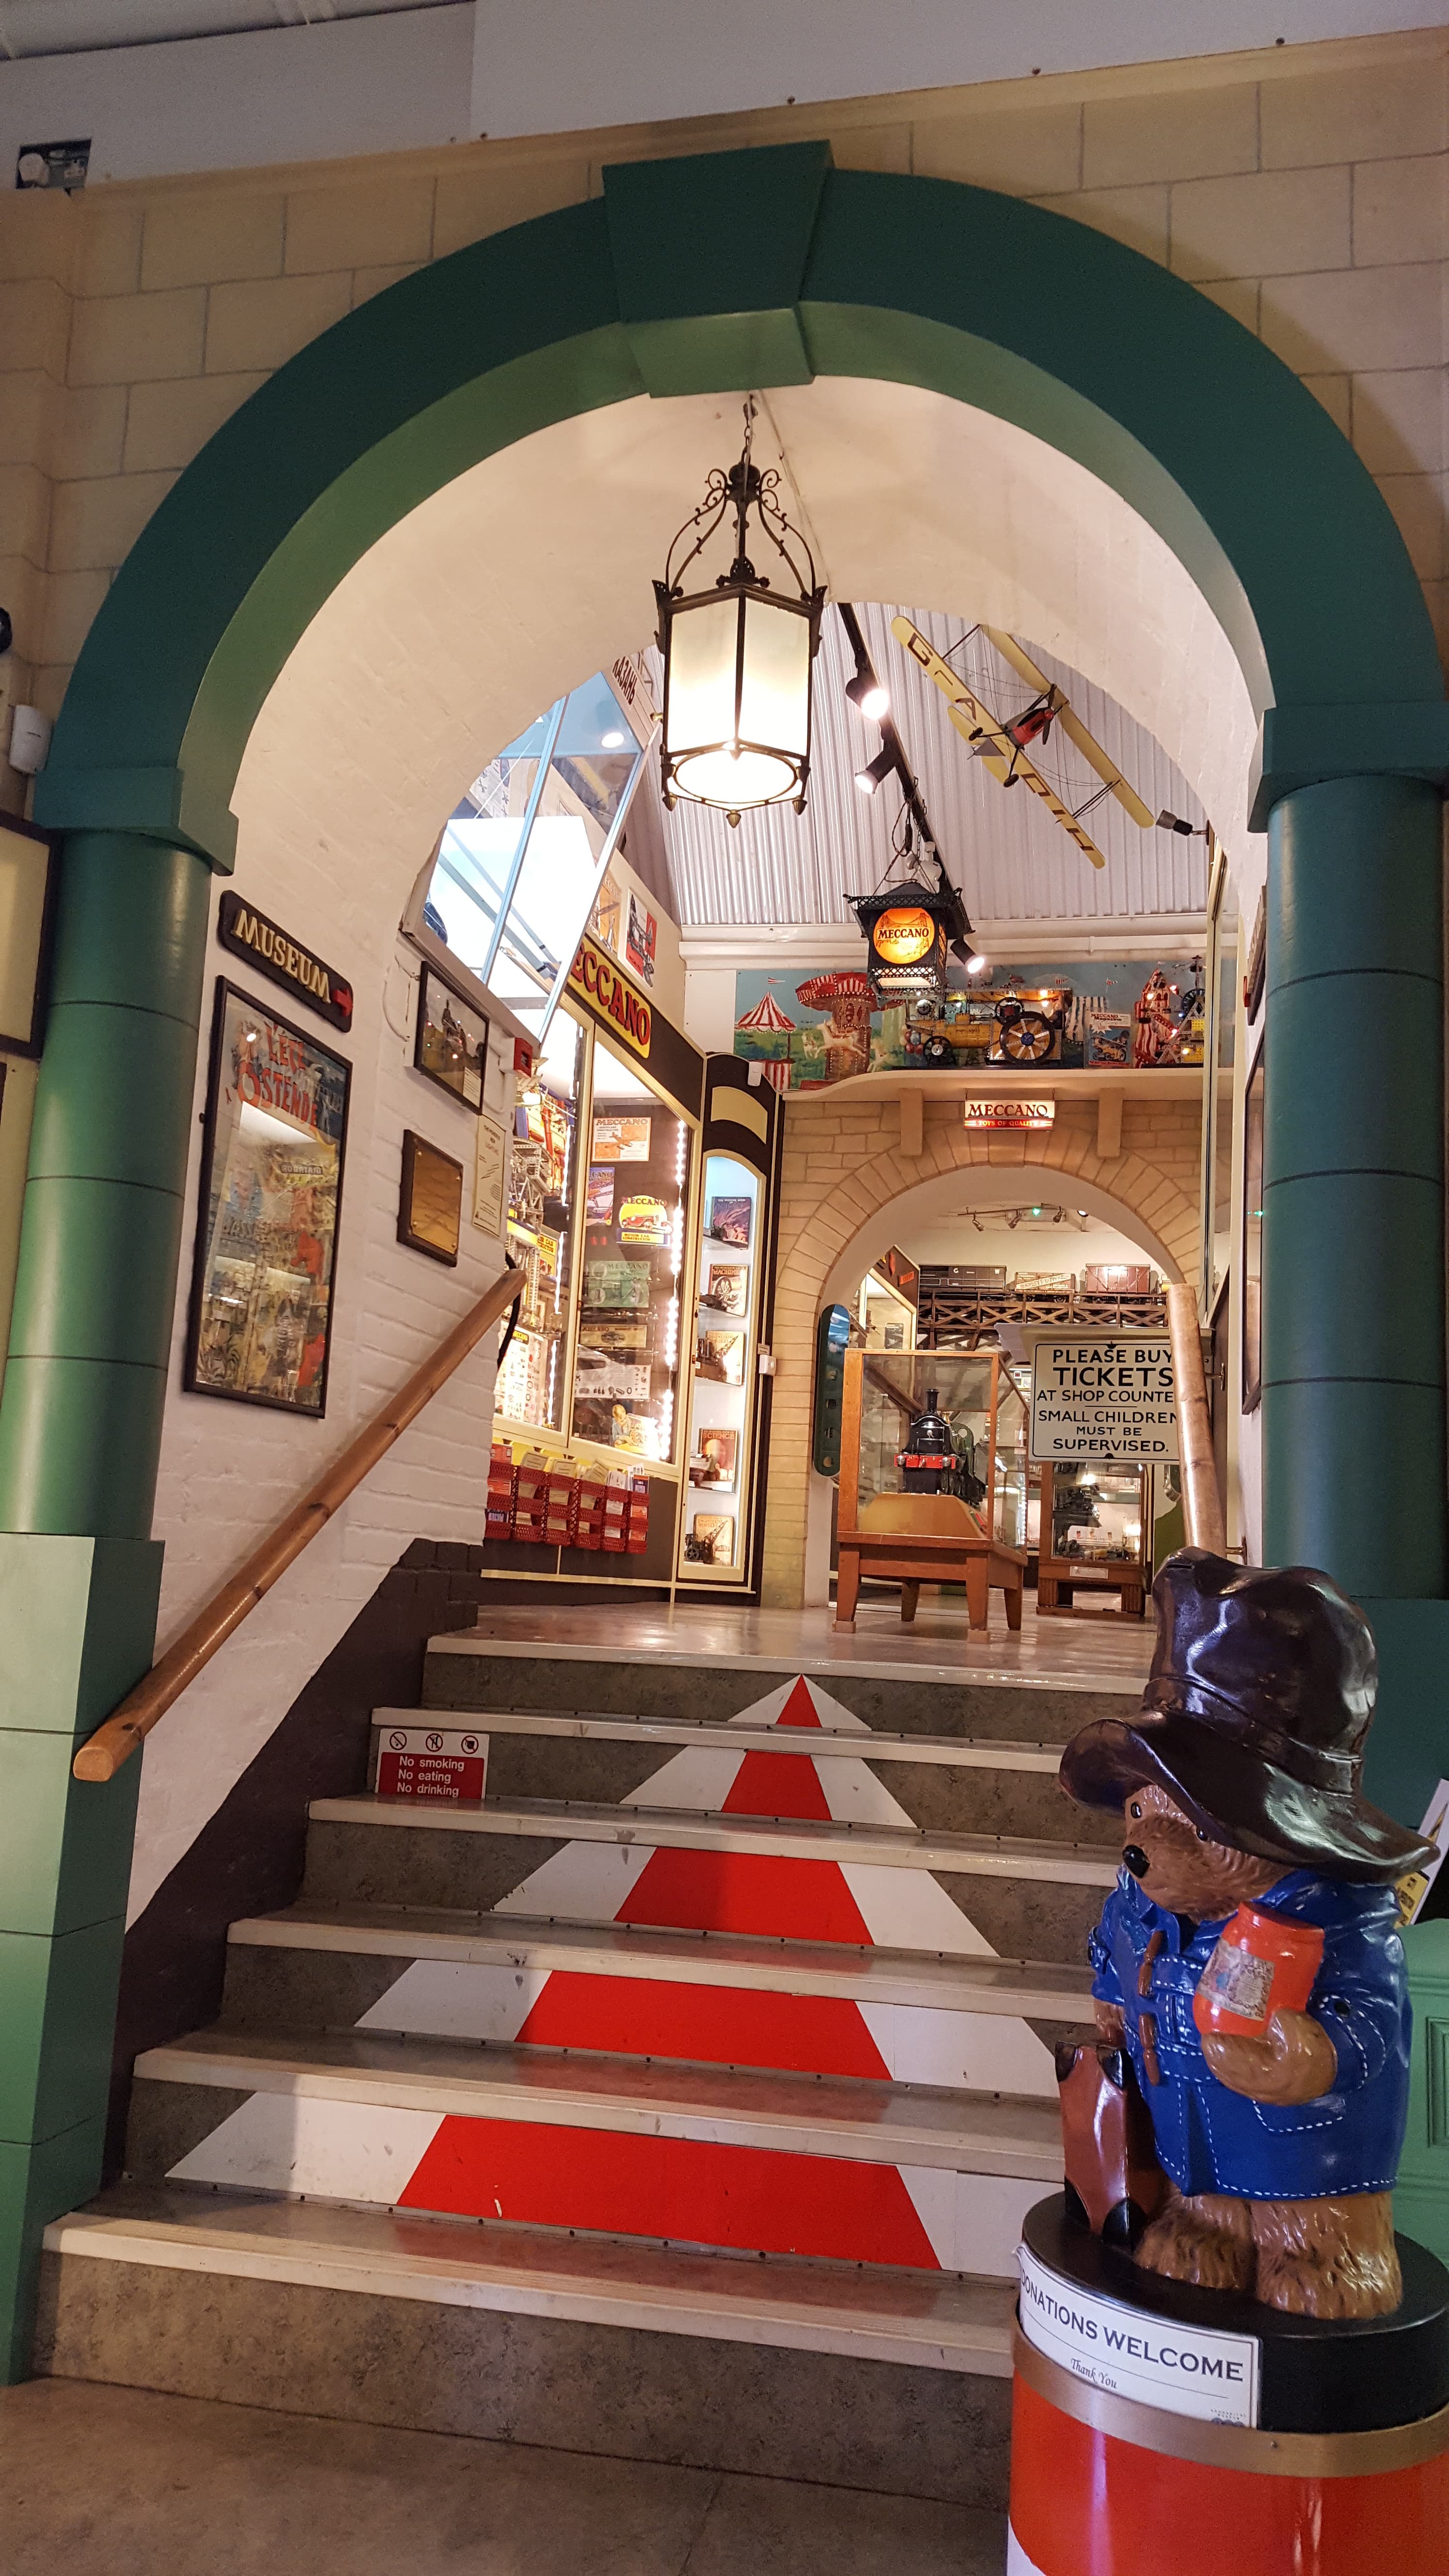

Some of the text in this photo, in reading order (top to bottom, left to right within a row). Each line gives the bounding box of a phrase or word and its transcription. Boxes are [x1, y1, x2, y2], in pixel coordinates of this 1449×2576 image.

[877, 928, 929, 939] MECCANO
[230, 909, 331, 1004] MUSEUM
[570, 941, 650, 1046] ECCANO
[237, 1060, 319, 1131] OSTENDE
[968, 1104, 1047, 1117] MECCANO
[621, 1197, 667, 1207] MECCANO
[1053, 1349, 1173, 1364] PLEASE BUY
[1053, 1367, 1174, 1387] TICKETS
[1037, 1390, 1174, 1403] AT SHOP COUNTE
[1038, 1410, 1090, 1422] SMALL
[1076, 1426, 1142, 1436] MUST BE
[1053, 1438, 1169, 1452] SUPERVISED.
[399, 1755, 465, 1772] No smoking
[398, 1769, 451, 1784] No eating
[397, 1782, 459, 1798] No drinking
[1021, 2268, 1243, 2382] DONATIONS WELCOME
[1070, 2358, 1117, 2389] Thank You
